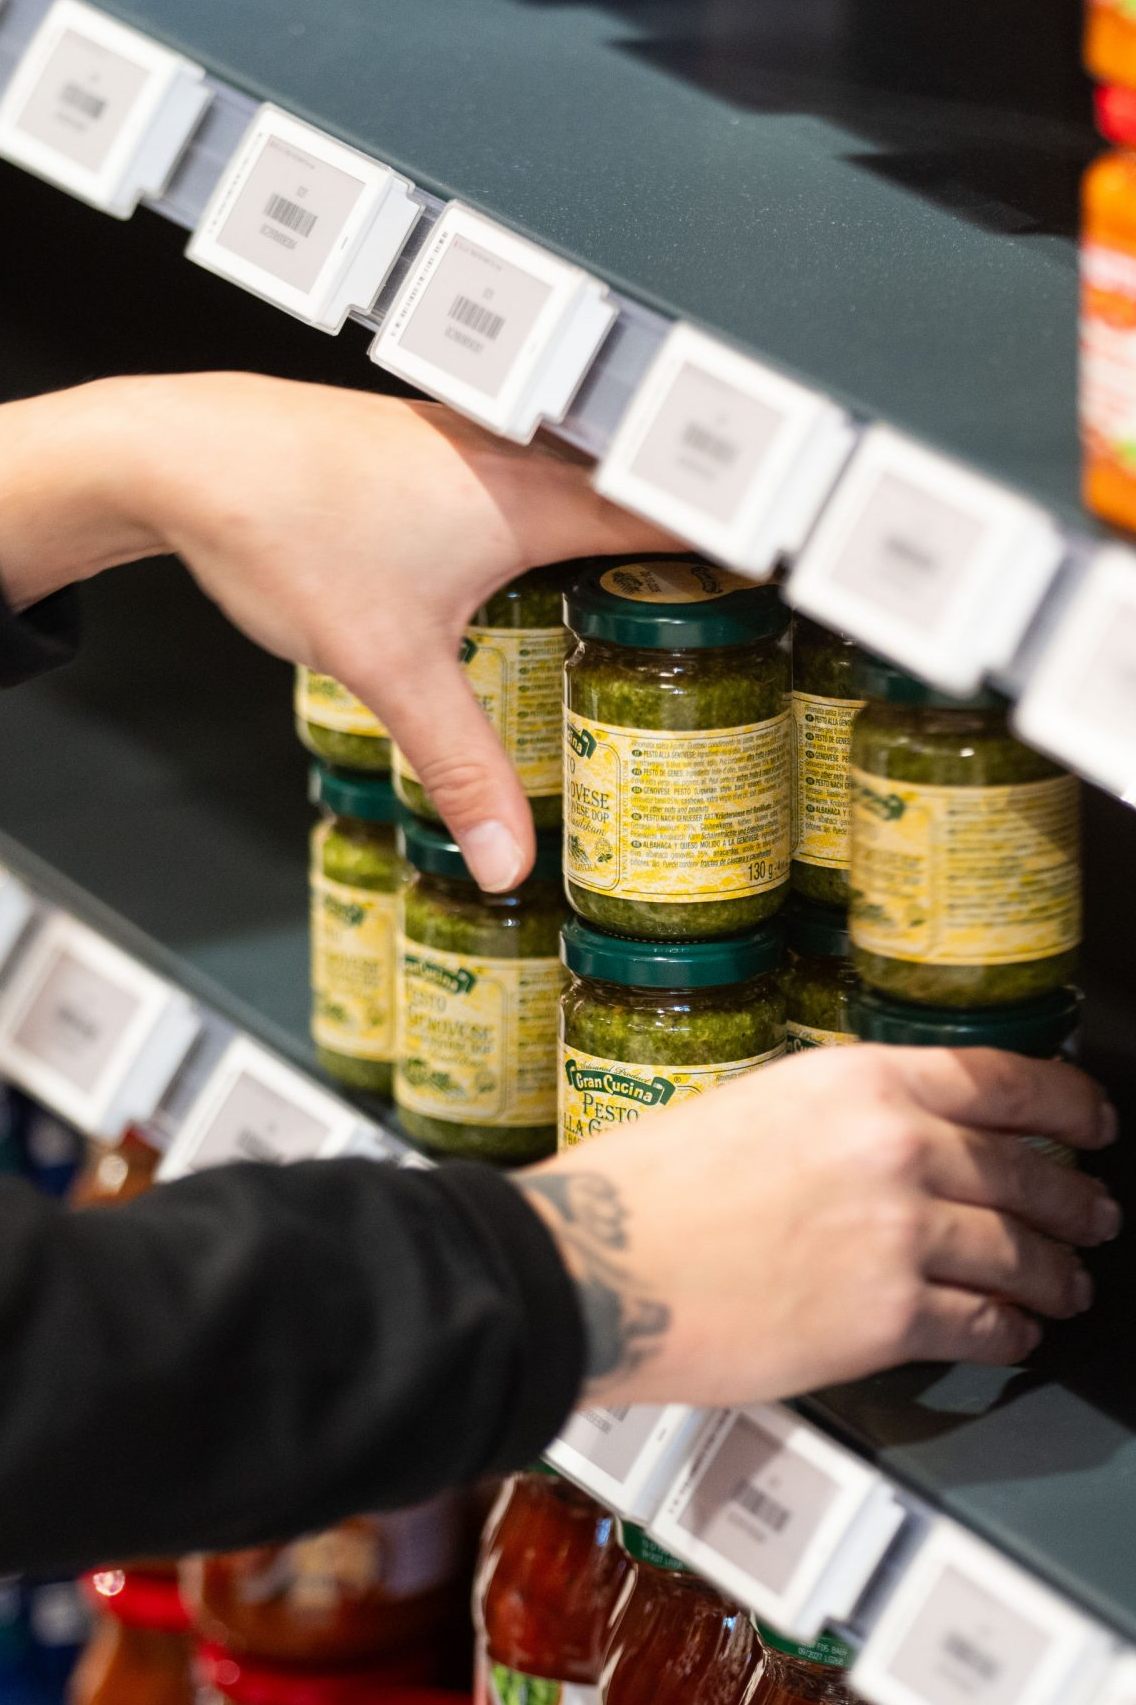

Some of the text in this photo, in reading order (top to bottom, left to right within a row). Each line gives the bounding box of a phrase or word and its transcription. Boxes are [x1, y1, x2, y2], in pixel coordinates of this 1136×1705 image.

[570, 781, 610, 810] OVESE
[748, 860, 766, 881] 130
[768, 863, 773, 879] g
[582, 1092, 639, 1123] PESTO
